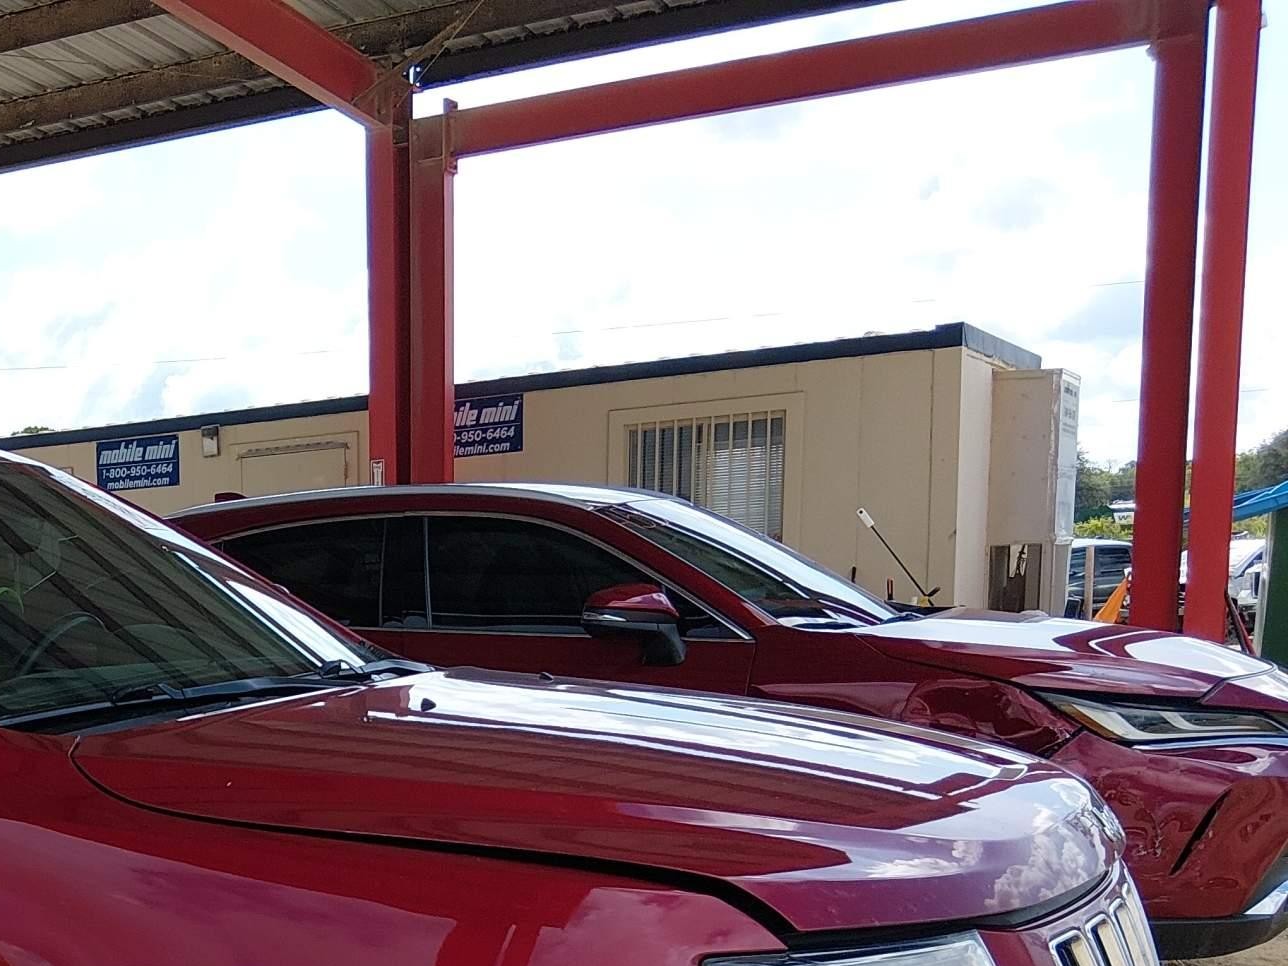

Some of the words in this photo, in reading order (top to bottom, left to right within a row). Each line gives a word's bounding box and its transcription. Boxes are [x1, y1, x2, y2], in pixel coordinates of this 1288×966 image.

[479, 400, 520, 424] mini
[99, 440, 144, 465] mobile
[144, 439, 177, 461] mini
[102, 463, 173, 480] 1-800-950-6464
[107, 476, 170, 490] mobilemini.com
